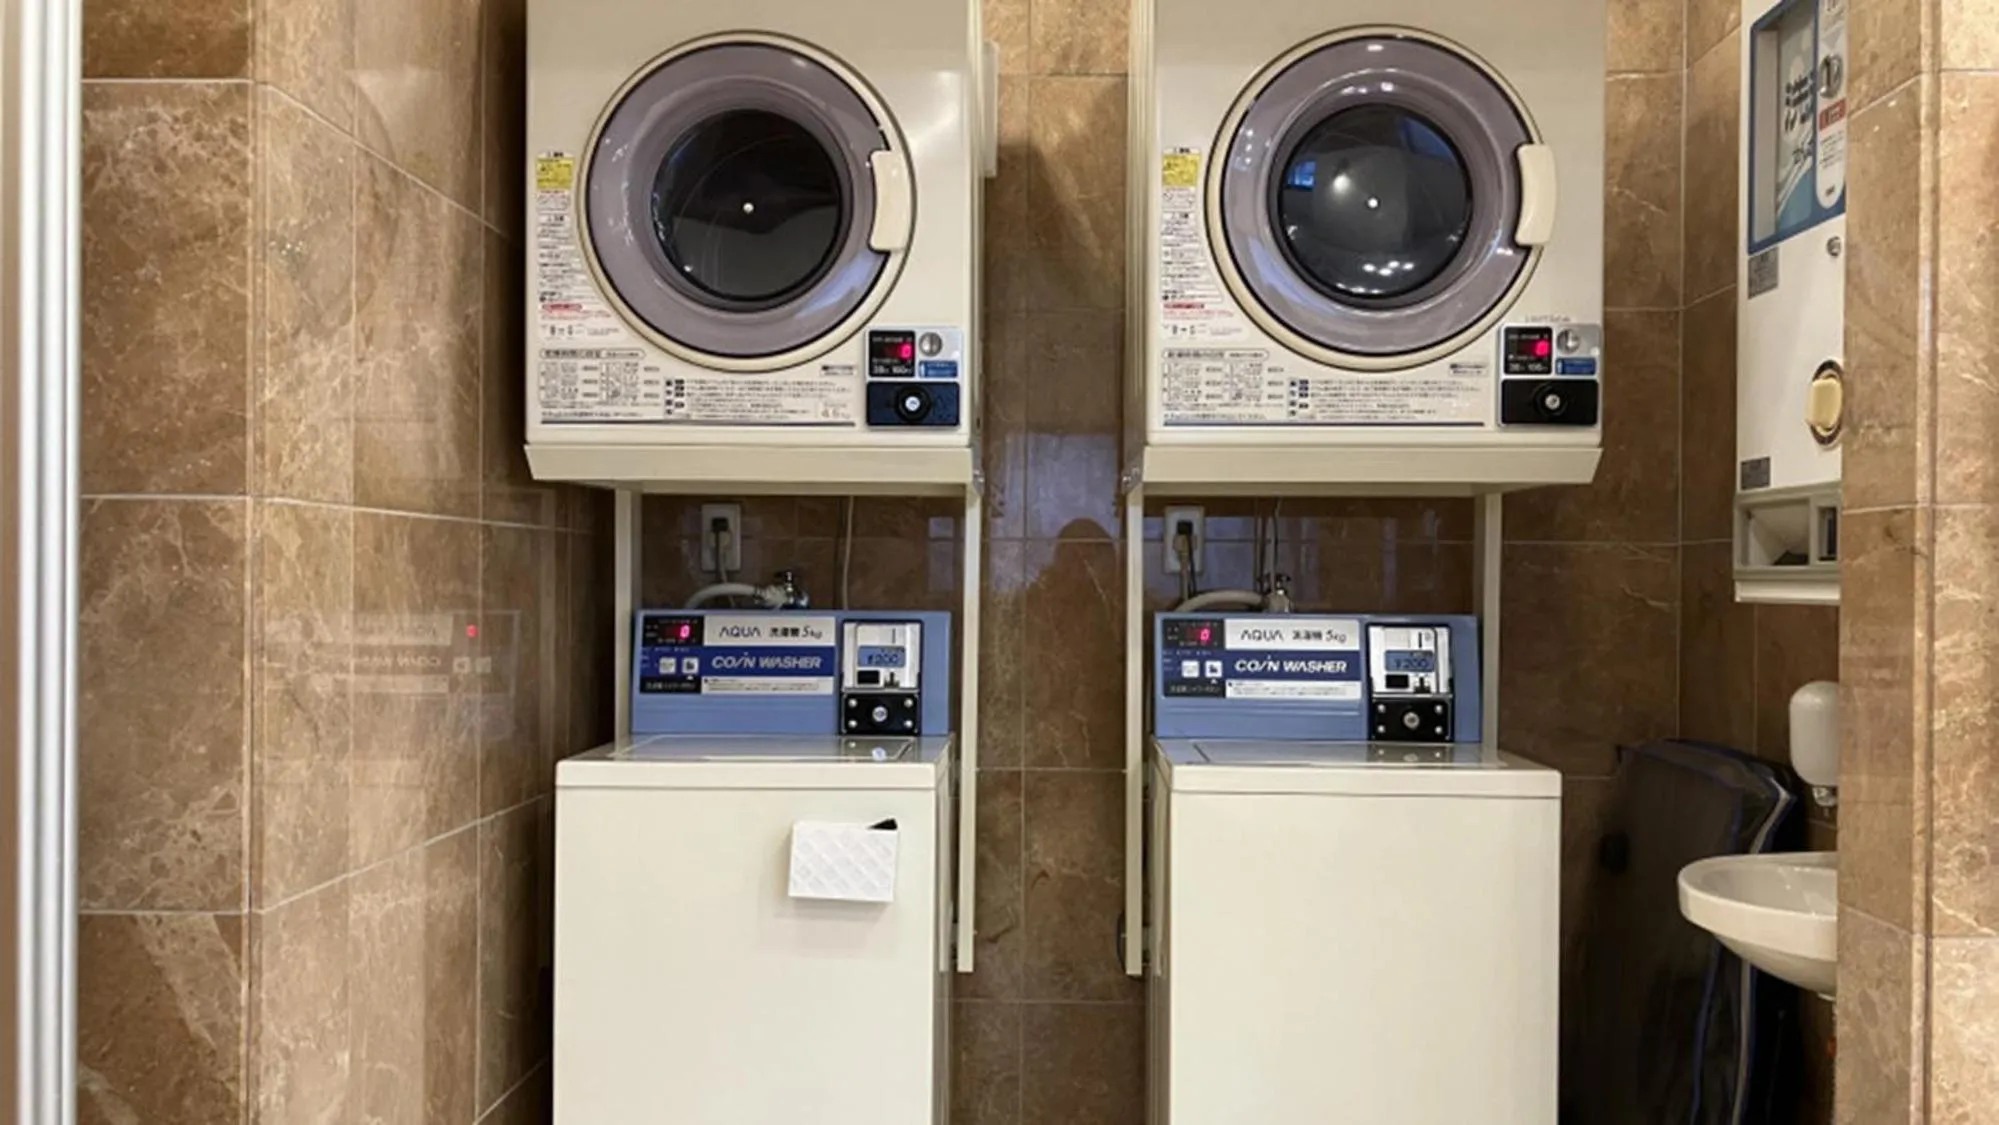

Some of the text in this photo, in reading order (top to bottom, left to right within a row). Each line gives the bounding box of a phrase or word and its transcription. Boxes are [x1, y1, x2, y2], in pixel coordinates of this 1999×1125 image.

[680, 624, 690, 639] 0
[719, 625, 762, 638] AQUA
[1240, 628, 1285, 642] AQUA
[711, 651, 824, 669] COIN WASHER
[1235, 654, 1348, 673] COIN WASHER
